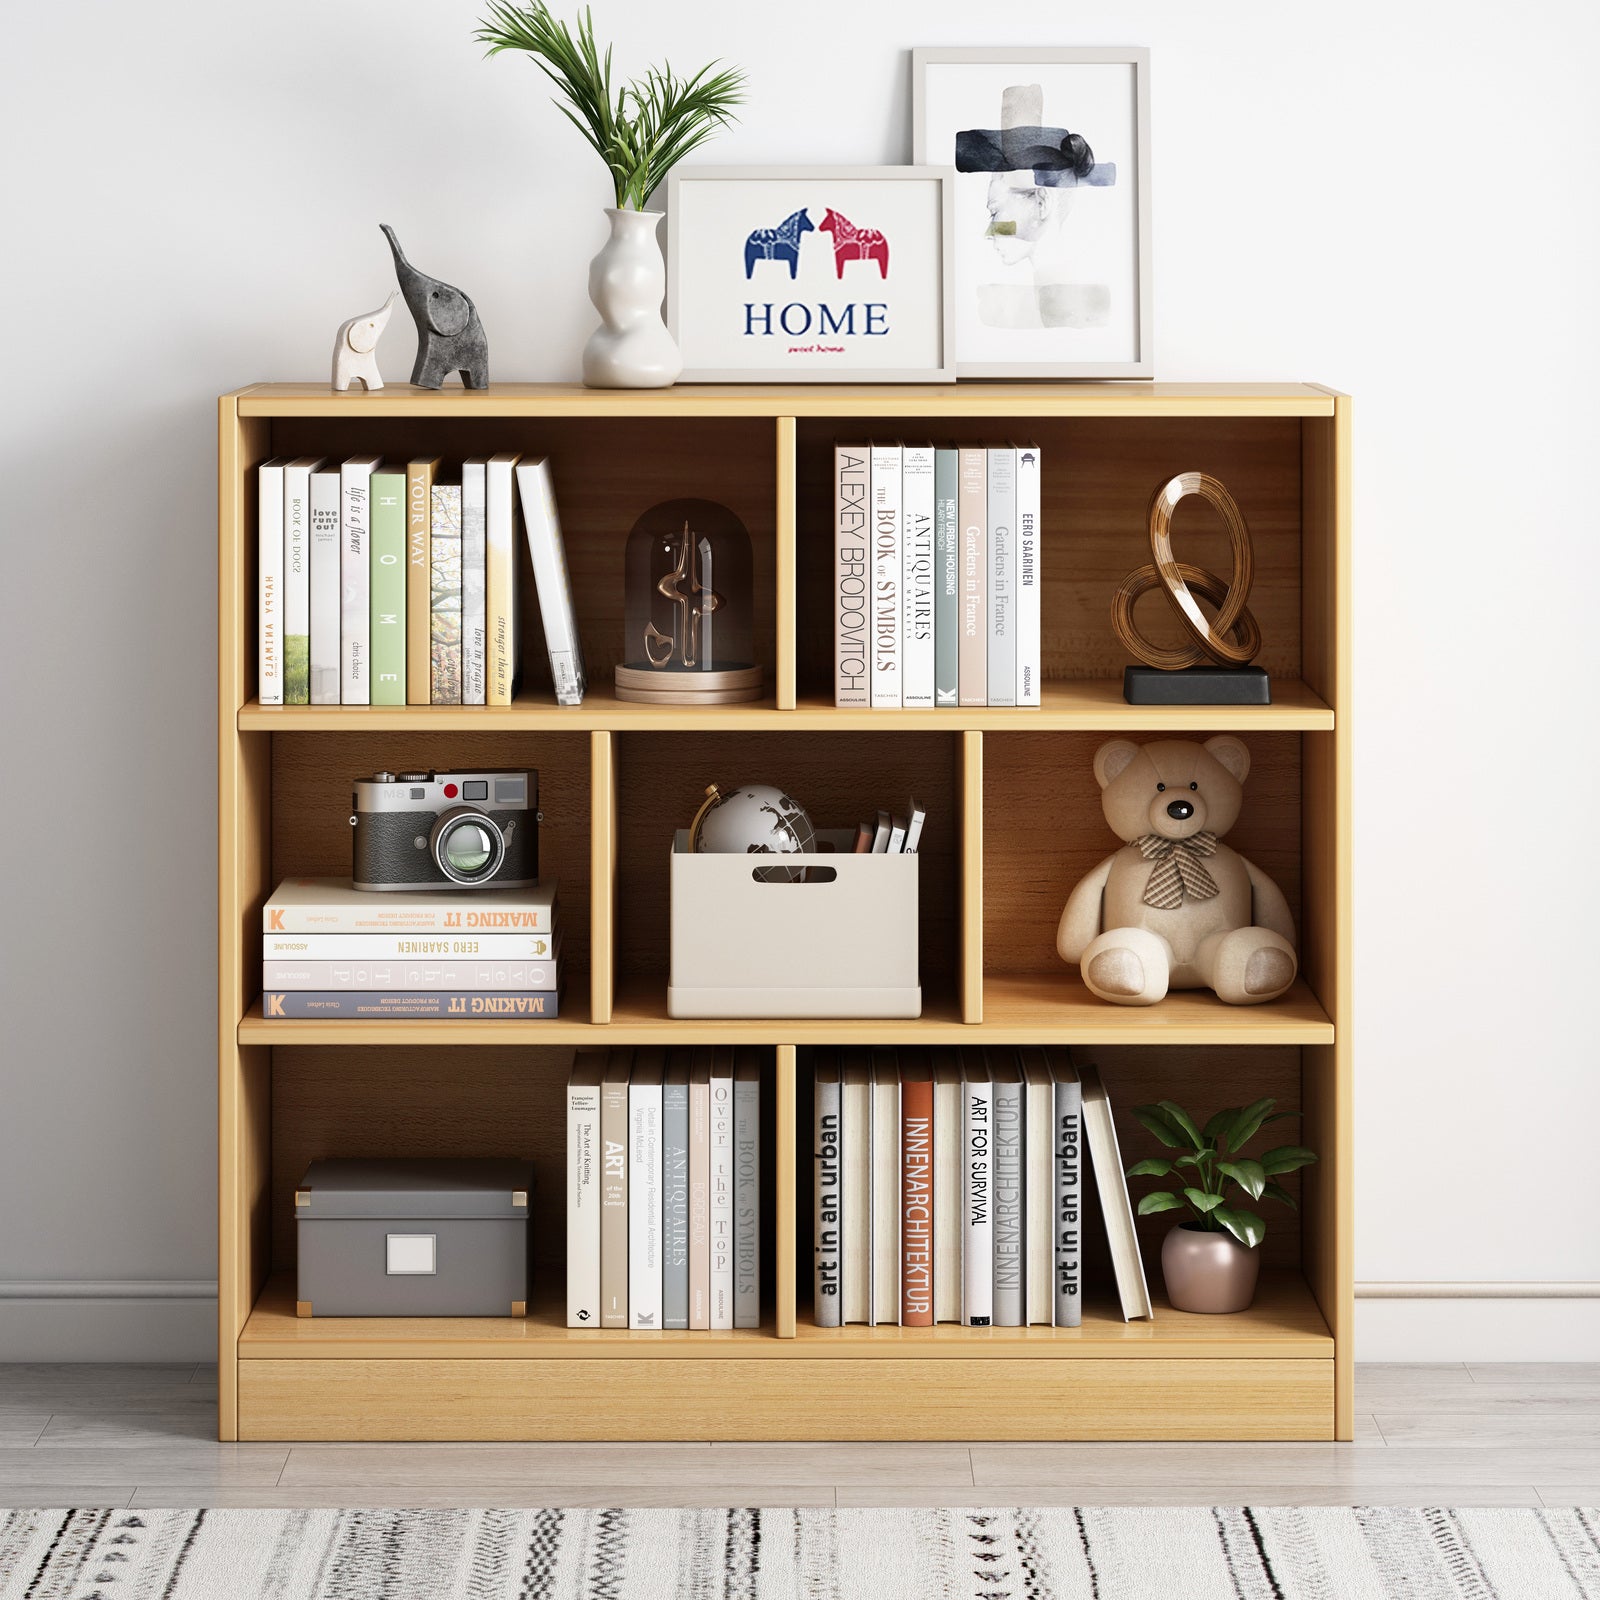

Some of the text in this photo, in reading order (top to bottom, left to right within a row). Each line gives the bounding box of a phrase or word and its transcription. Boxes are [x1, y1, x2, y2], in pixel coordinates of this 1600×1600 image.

[743, 302, 890, 336] HOME
[312, 516, 338, 524] runs
[313, 508, 338, 517] love
[316, 523, 335, 531] out
[345, 487, 366, 555] life is a flower
[411, 474, 425, 568] YOUR WAY
[937, 499, 945, 551] HILARY FRENCH
[946, 499, 955, 596] NEW URBAN HOUSING
[840, 454, 865, 691] ALEXEY BRODOVITCH
[876, 486, 896, 672] THE BOOK OF SYMBOLS
[912, 514, 931, 640] ANTIQUAIRES
[966, 526, 981, 637] Gardens in France
[995, 526, 1009, 637] Gardens in France
[1022, 513, 1034, 586] EERO SAARINEN
[379, 496, 397, 682] HOME
[352, 641, 363, 680] chris choice
[470, 627, 485, 694] love in prague
[494, 616, 508, 697] stronger than sin
[1023, 665, 1031, 697] ASSOULINE
[398, 941, 479, 953] EERO SAARINEN
[443, 912, 538, 927] MAKING IT
[447, 997, 545, 1013] MAKING IT
[480, 967, 546, 985] Over
[582, 1158, 591, 1185] Knitting
[584, 1149, 591, 1157] of
[605, 1141, 624, 1179] ART
[715, 1087, 727, 1270] Over the Top
[738, 1140, 755, 1188] BOOK
[971, 1096, 988, 1226] ART FOR SURVIVAL
[671, 1146, 687, 1266] ANTIQUAIRES
[815, 1114, 838, 1296] art in an urban
[905, 1117, 930, 1314] INNENARCHITEKTUR
[995, 1097, 1019, 1291] INNENARCHITEKTUR
[1056, 1114, 1079, 1296] art in an urban
[738, 1208, 755, 1294] SYMBOLS
